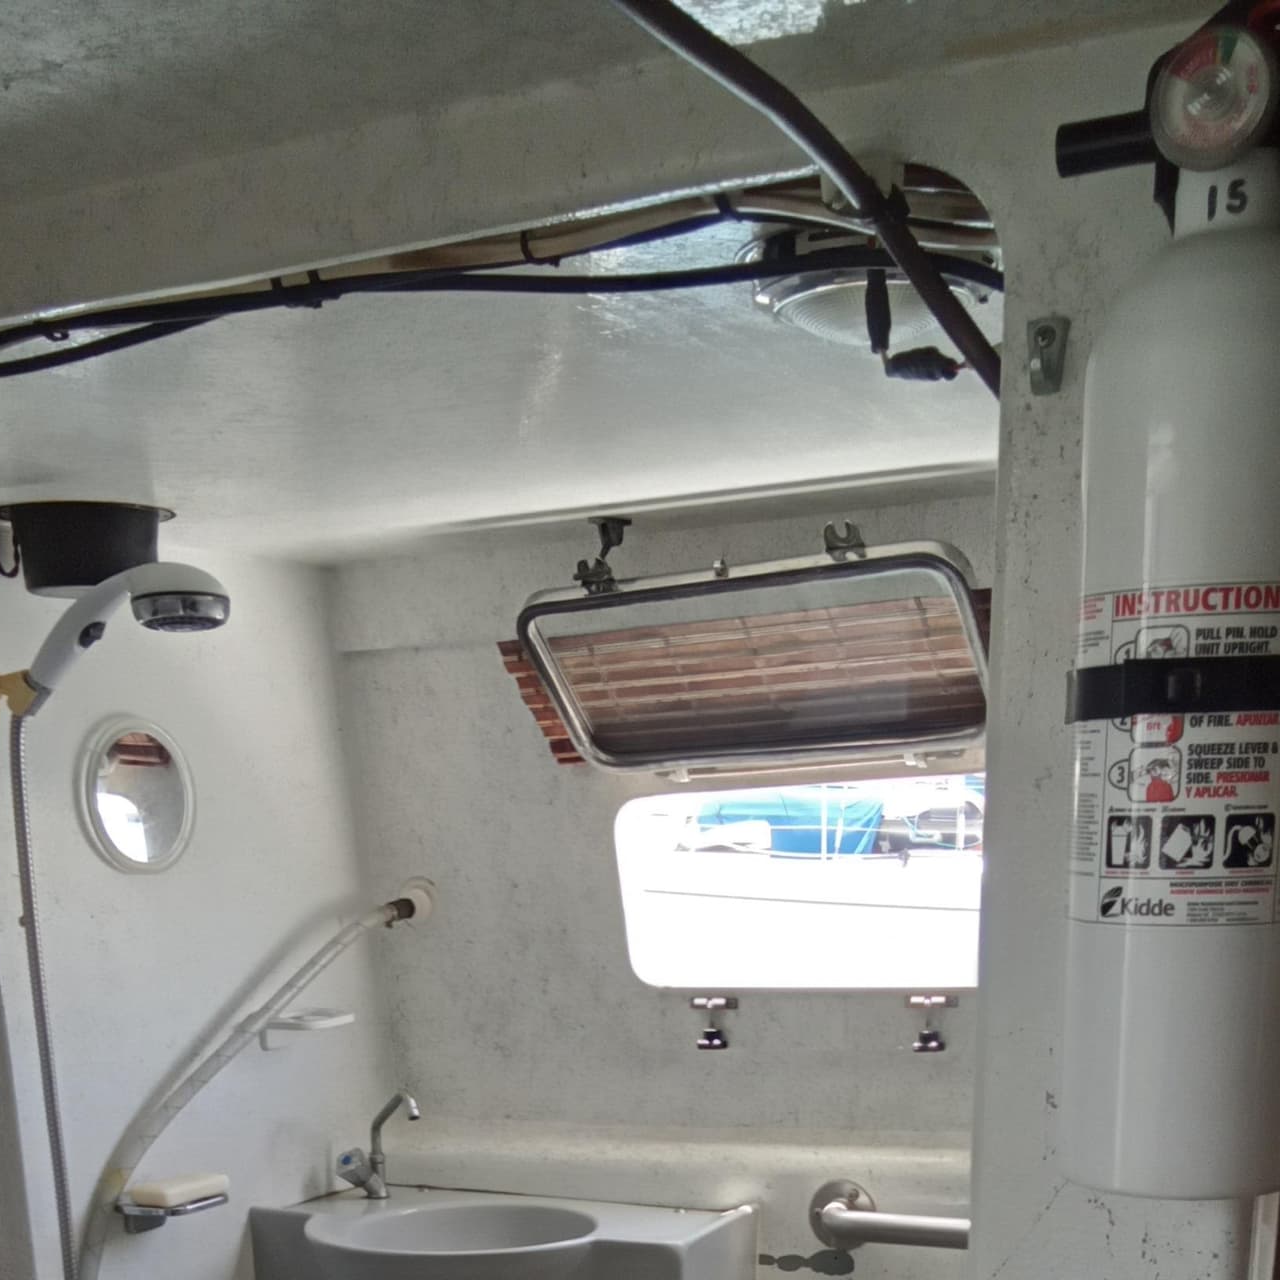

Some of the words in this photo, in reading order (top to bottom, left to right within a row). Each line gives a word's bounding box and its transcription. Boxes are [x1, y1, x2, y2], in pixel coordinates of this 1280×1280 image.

[1208, 178, 1248, 221] 15
[1195, 627, 1221, 640] PULL
[1249, 625, 1278, 638] HOLD
[1195, 642, 1221, 655] UNIT
[1189, 715, 1204, 728] OF
[1207, 714, 1233, 728] FIRE.
[1187, 743, 1236, 757] SQUEEZE
[1238, 742, 1269, 755] LEVER
[1186, 757, 1223, 770] SWEEP
[1226, 756, 1250, 769] SIDE
[1253, 756, 1266, 768] TO
[1116, 766, 1126, 783] 3
[1185, 772, 1214, 785] SIDE.
[1185, 787, 1193, 799] Y
[1120, 897, 1176, 917] Kidde
